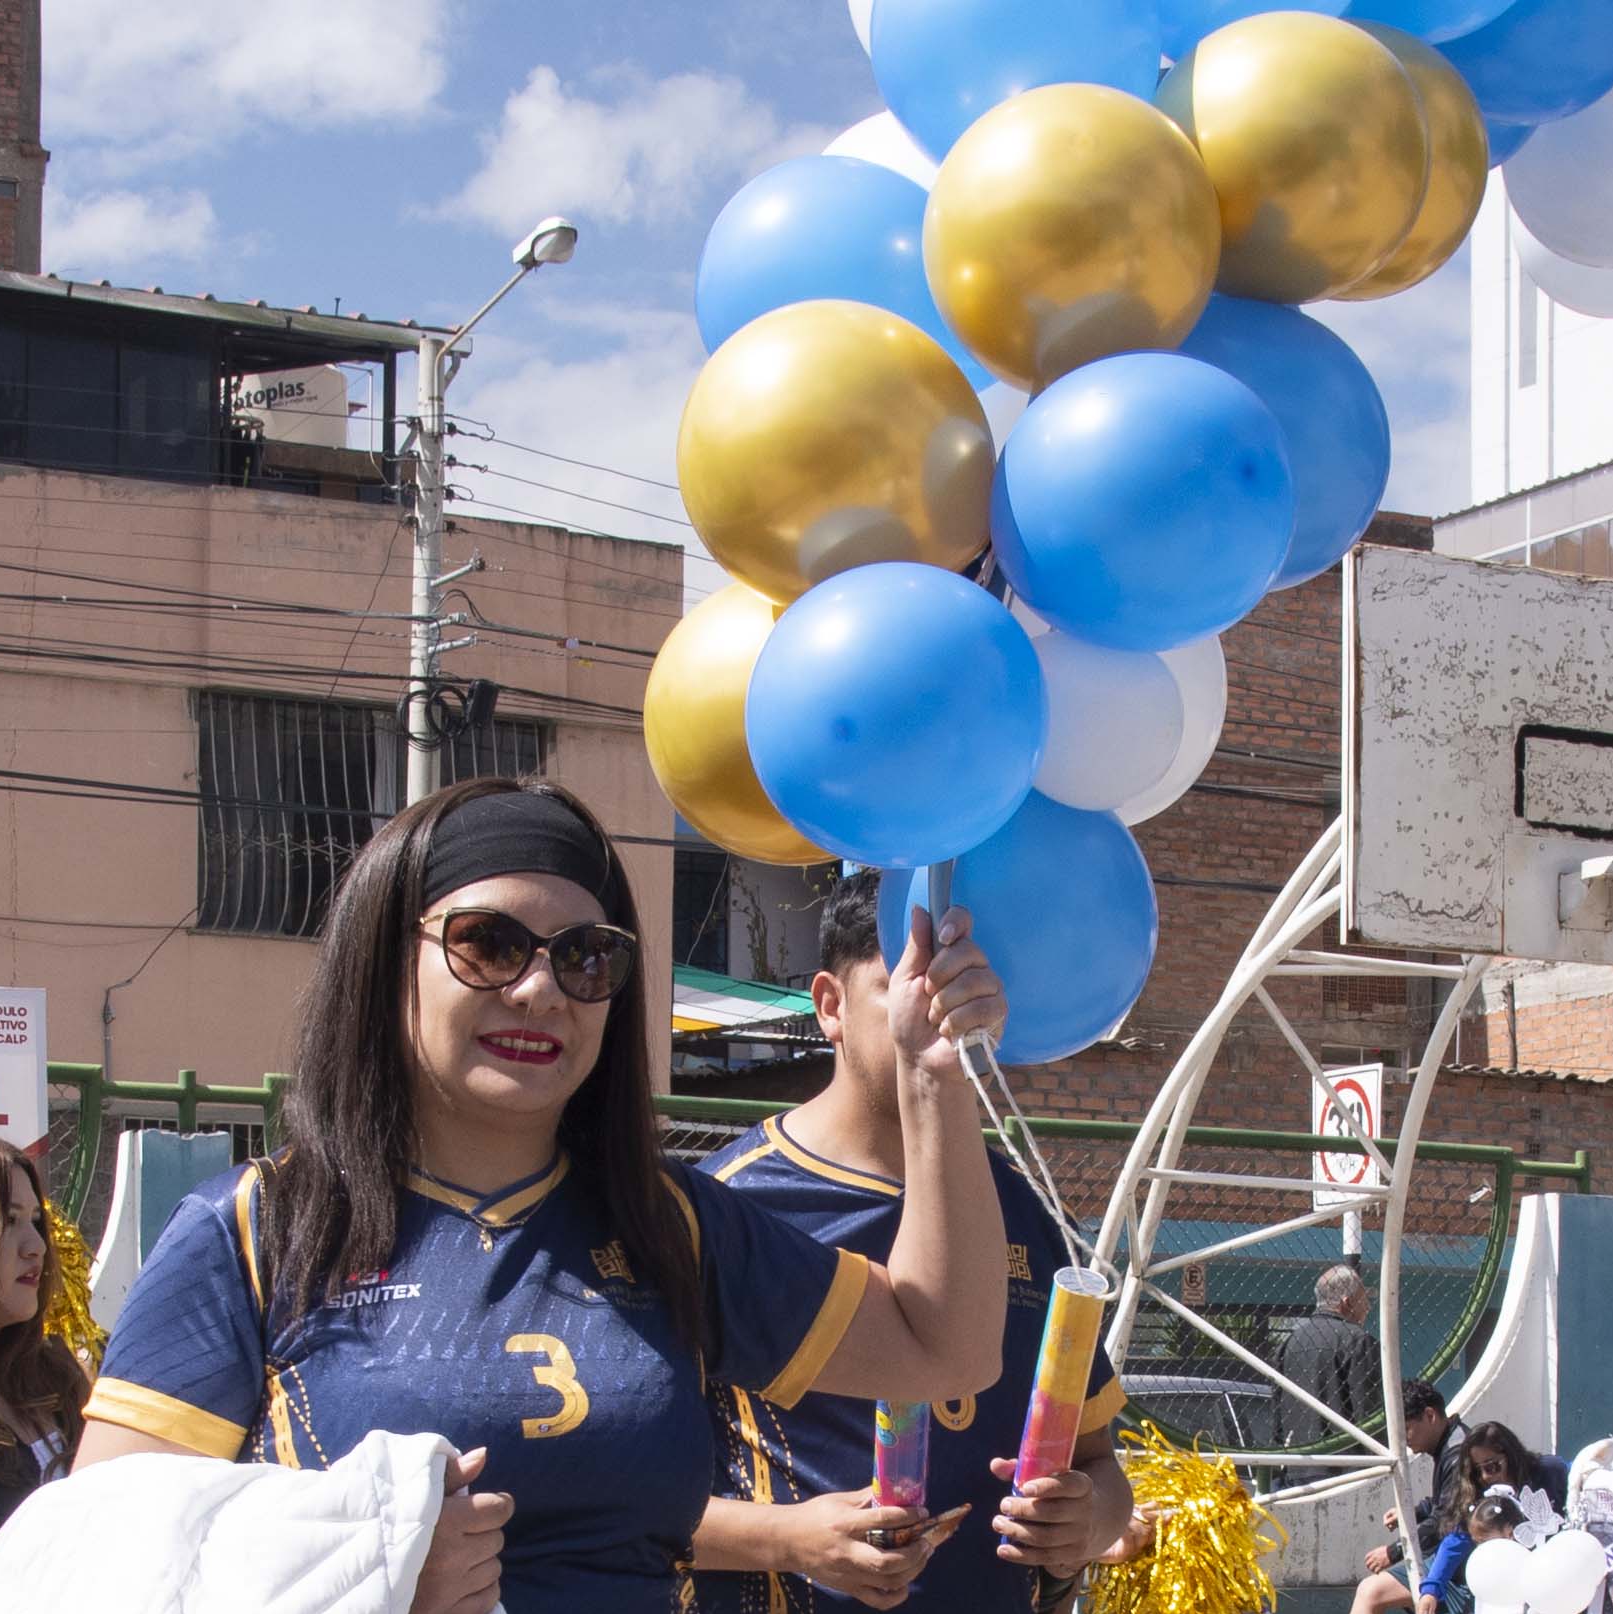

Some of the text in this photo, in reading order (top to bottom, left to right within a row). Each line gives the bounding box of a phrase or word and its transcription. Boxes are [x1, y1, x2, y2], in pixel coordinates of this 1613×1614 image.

[234, 382, 305, 410] otoplas
[325, 1283, 423, 1309] SONITEX
[505, 1334, 589, 1439] 3
